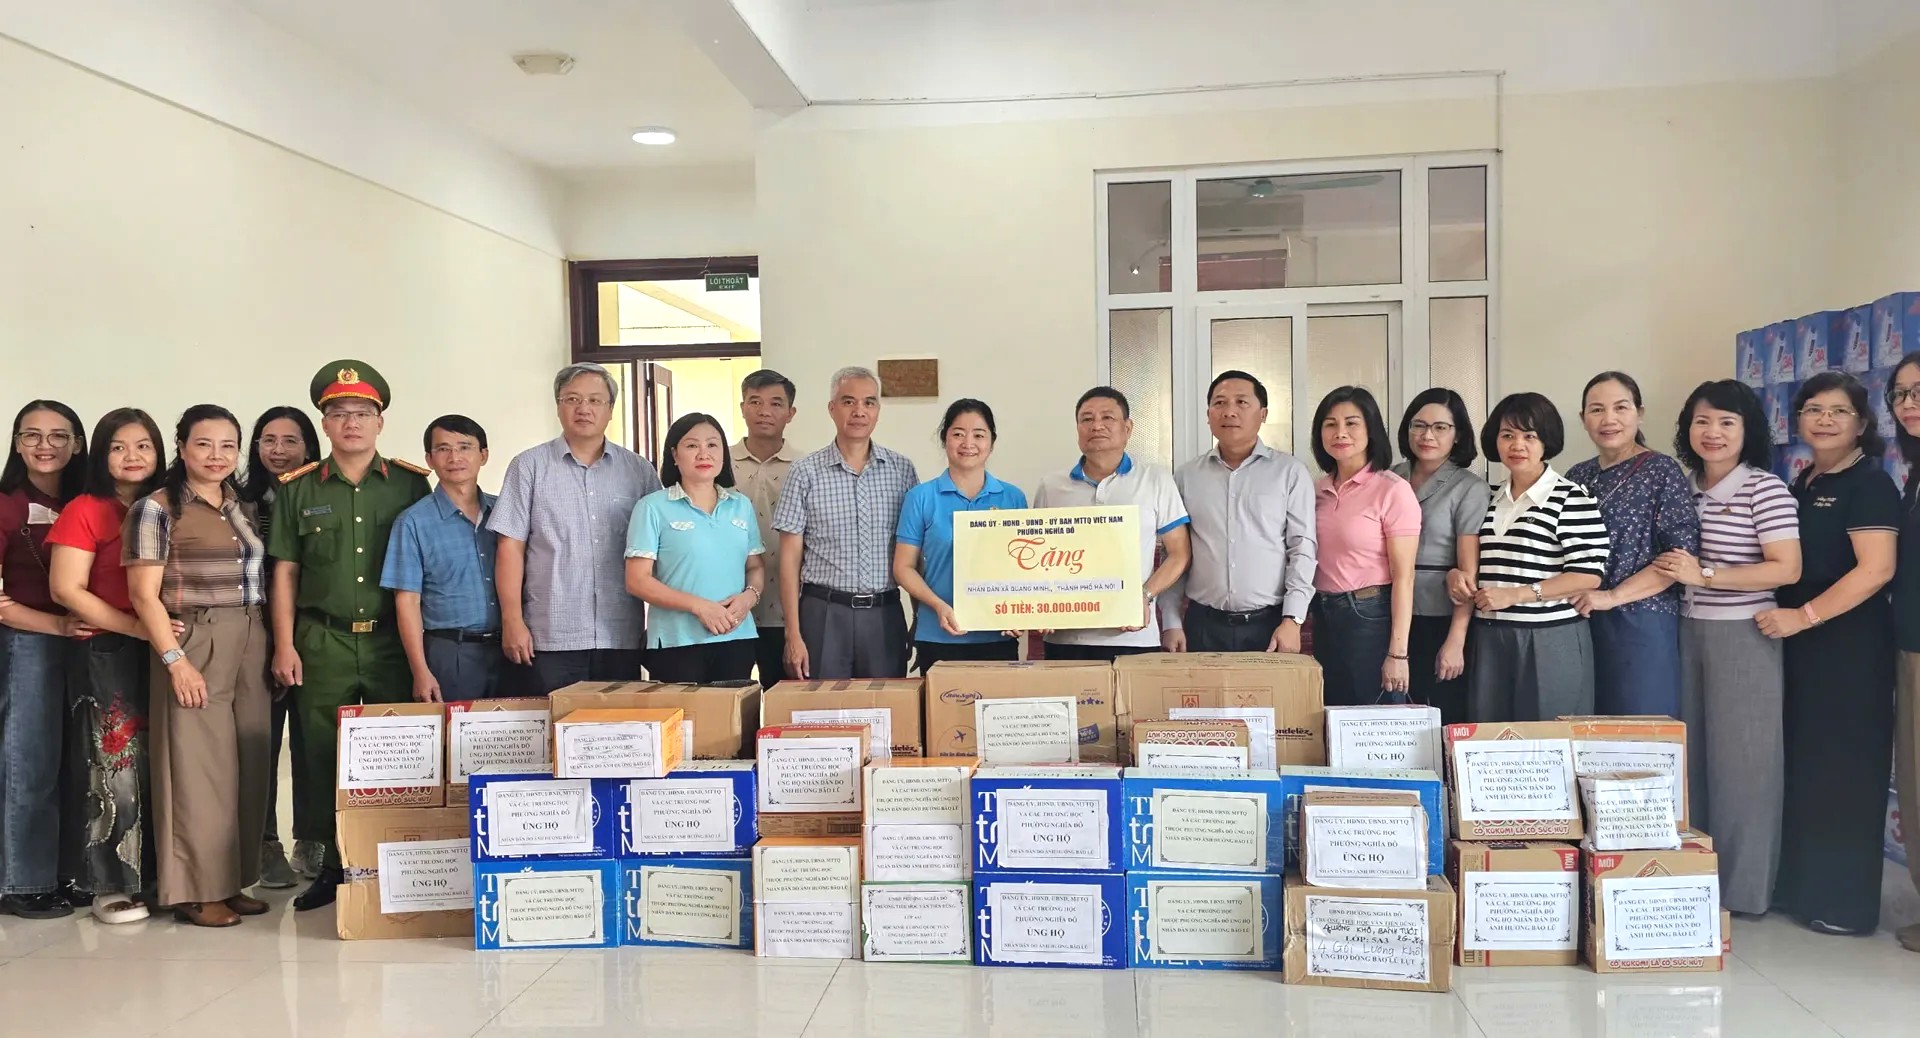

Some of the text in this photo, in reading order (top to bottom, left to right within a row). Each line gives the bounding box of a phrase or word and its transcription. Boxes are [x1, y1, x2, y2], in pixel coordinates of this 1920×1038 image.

[722, 276, 744, 284] THOÁT
[1008, 537, 1085, 574] Tặng
[995, 600, 1100, 614] SỐ TIỀN: 30.000.000đ
[1454, 727, 1469, 736] MỚI
[1368, 752, 1404, 762] ỦNG HỘ
[523, 820, 558, 830] ỦNG HỘ
[665, 819, 700, 829] ỦNG HỘ
[1033, 833, 1070, 843] ỦNG HỘ
[1344, 852, 1384, 863] ỦNG HỘ
[1565, 853, 1574, 868] MỚI
[1598, 858, 1614, 867] MỚI
[413, 878, 447, 888] ỦNG HỘ
[1027, 927, 1064, 938] ỦNG HỘ
